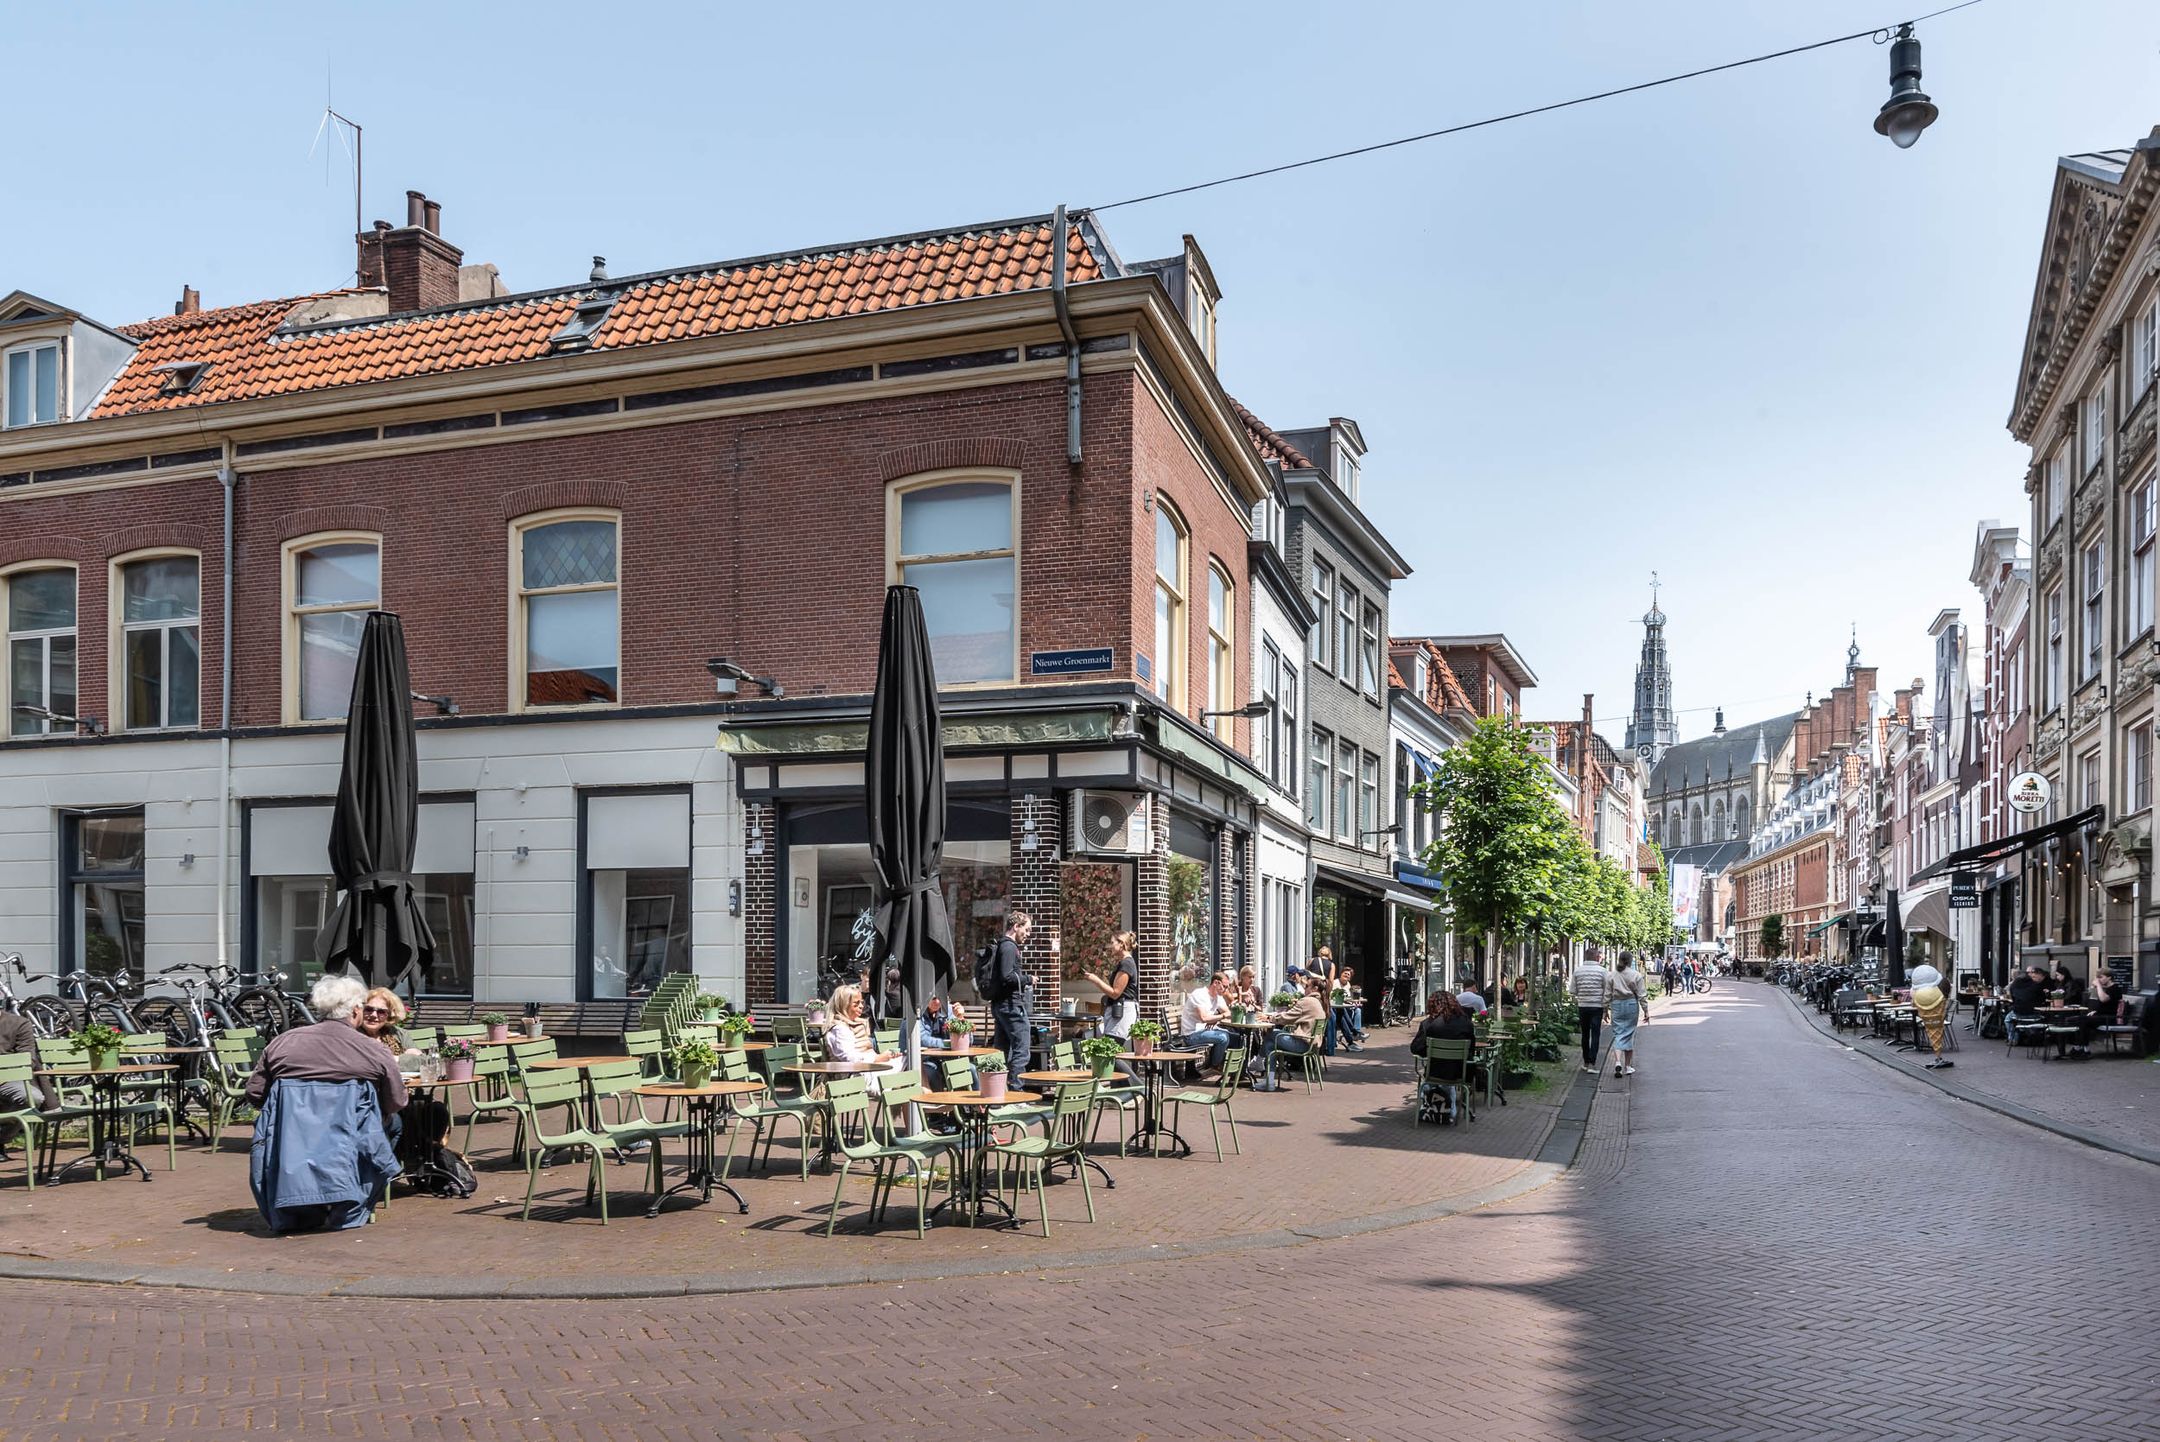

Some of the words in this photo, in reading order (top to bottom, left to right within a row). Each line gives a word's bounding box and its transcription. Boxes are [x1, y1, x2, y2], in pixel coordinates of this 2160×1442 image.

[1035, 658, 1063, 668] Nieuwe
[1064, 655, 1110, 666] Groenmarkt
[2013, 794, 2045, 803] MORETTI
